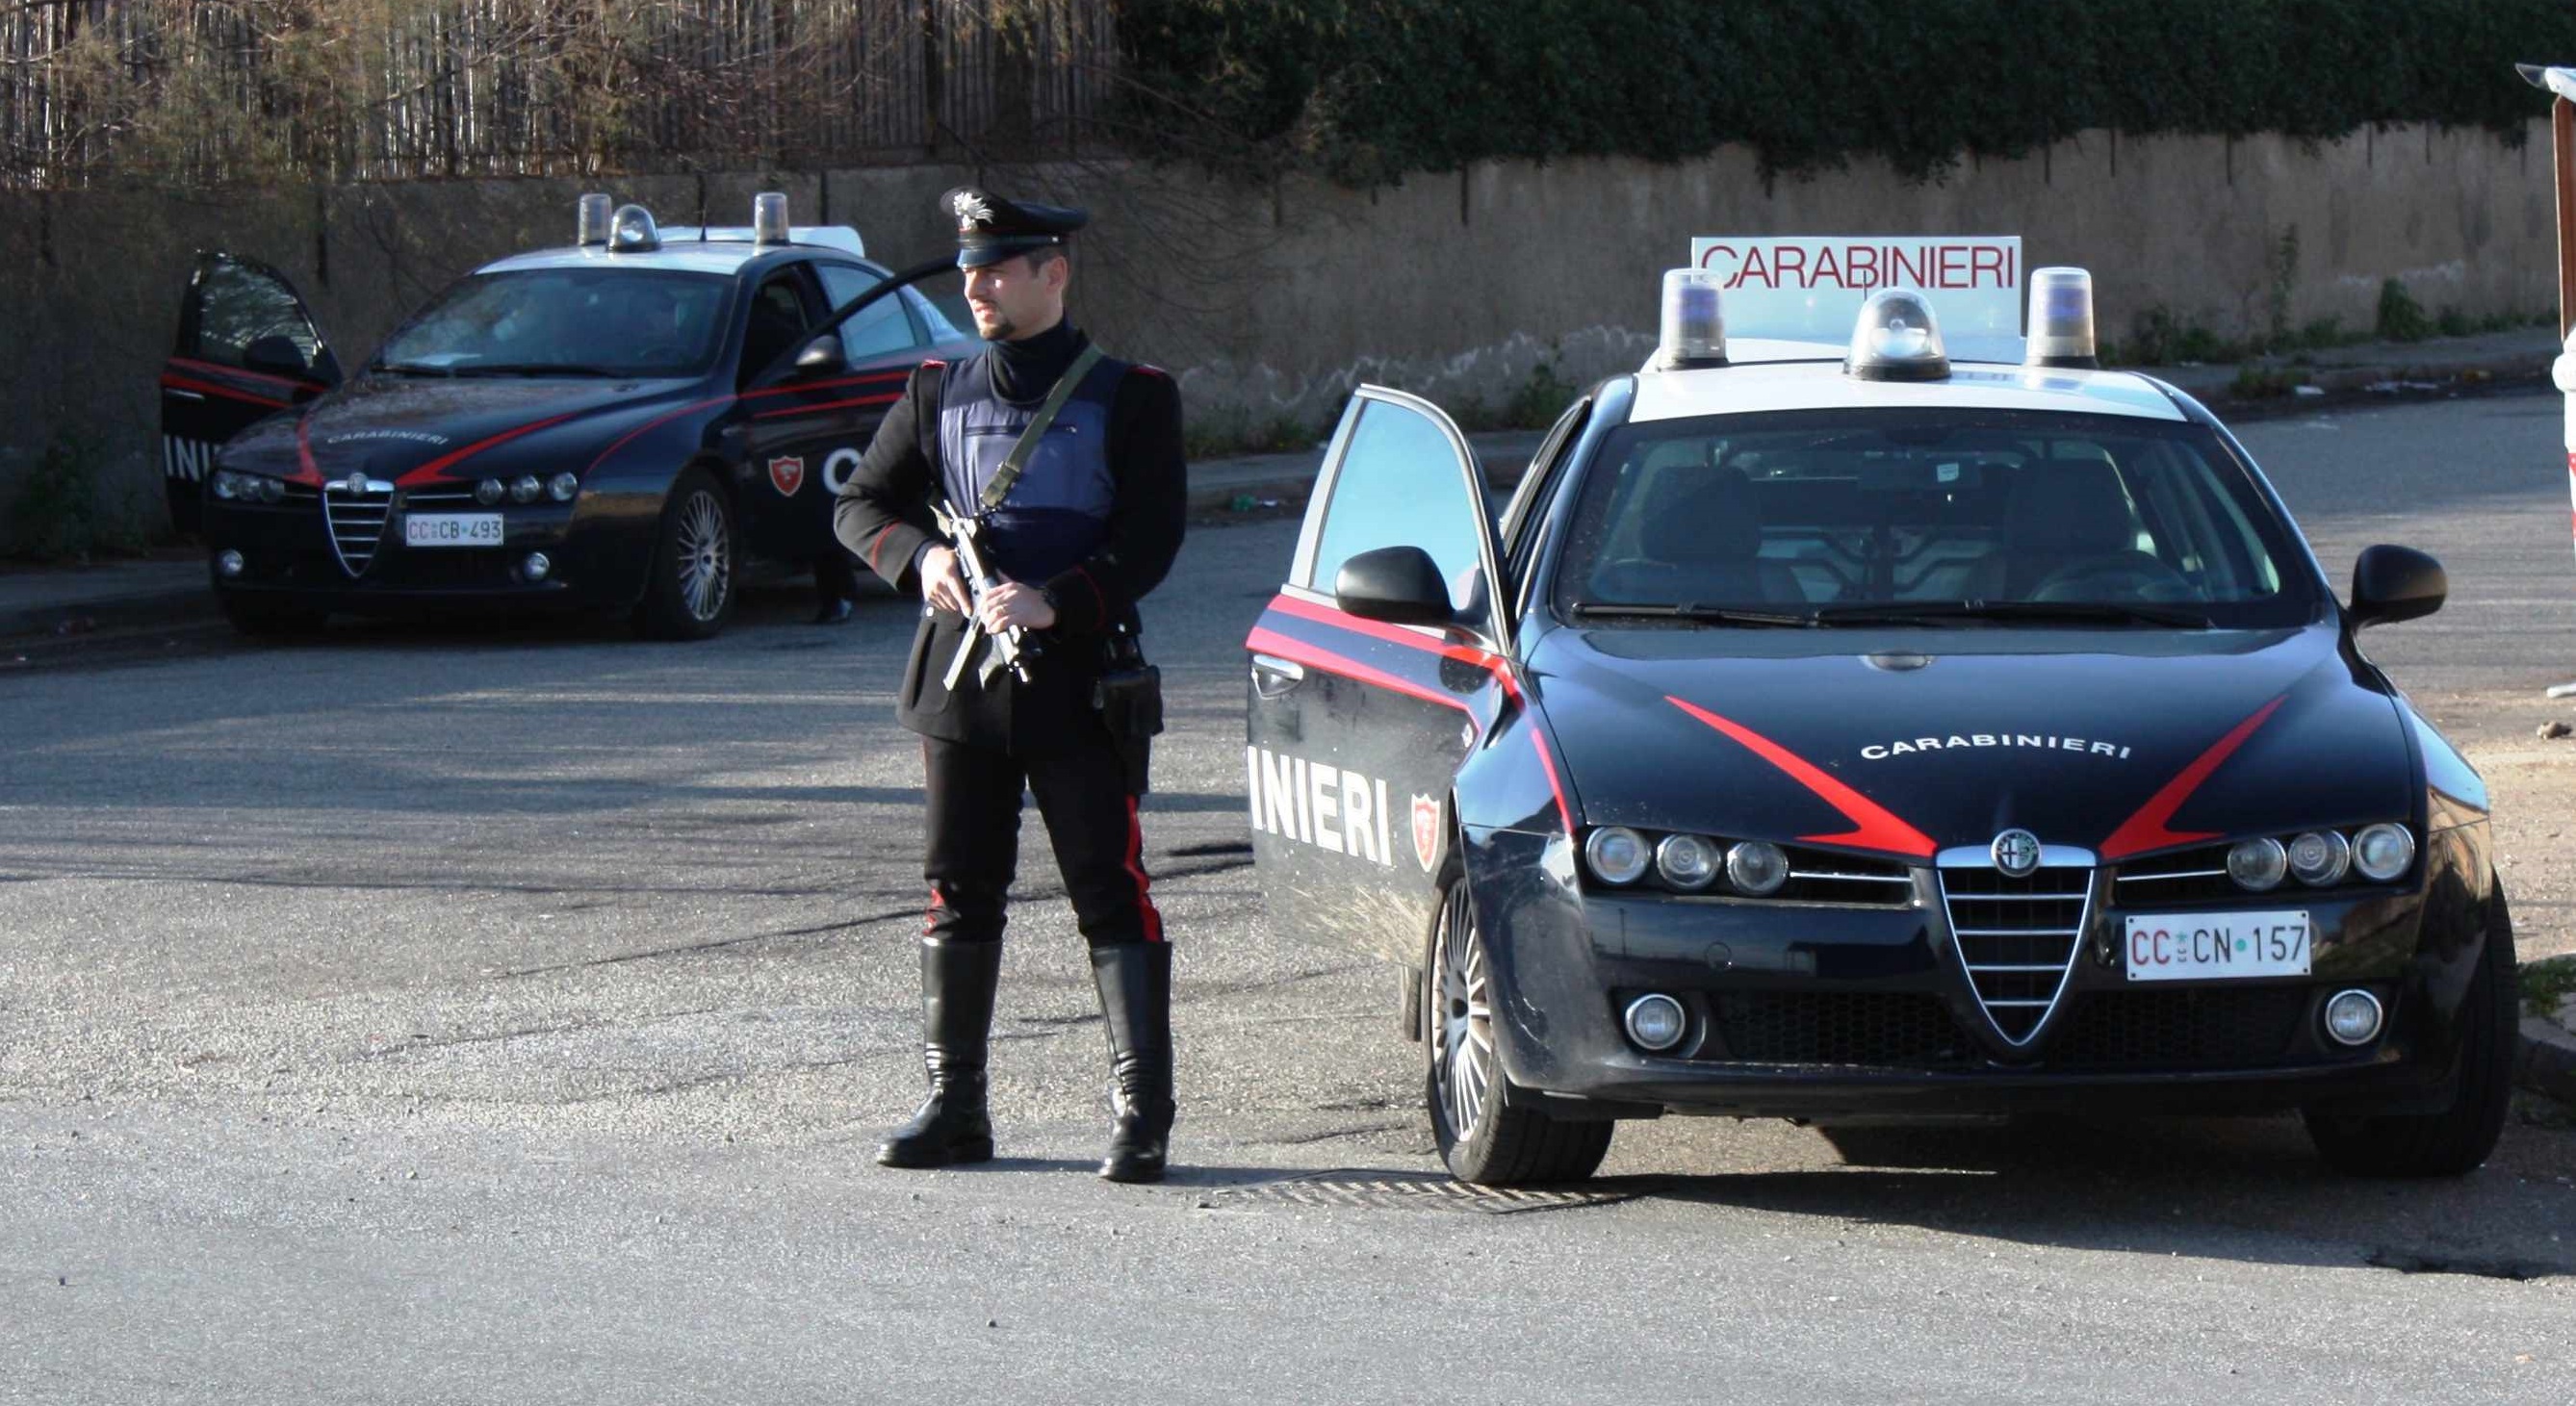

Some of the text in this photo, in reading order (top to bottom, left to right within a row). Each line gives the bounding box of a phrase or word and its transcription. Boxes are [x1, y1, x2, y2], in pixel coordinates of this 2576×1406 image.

[1701, 245, 2014, 289] CARABINIERI
[163, 434, 220, 481] INI
[327, 430, 449, 445] CARABINIERI
[470, 521, 501, 539] 493
[1860, 733, 2132, 760] CARABINIERI
[1248, 745, 1392, 866] INIERI
[2131, 930, 2171, 965] CC
[2194, 927, 2231, 962] CN
[2254, 925, 2306, 961] 157
